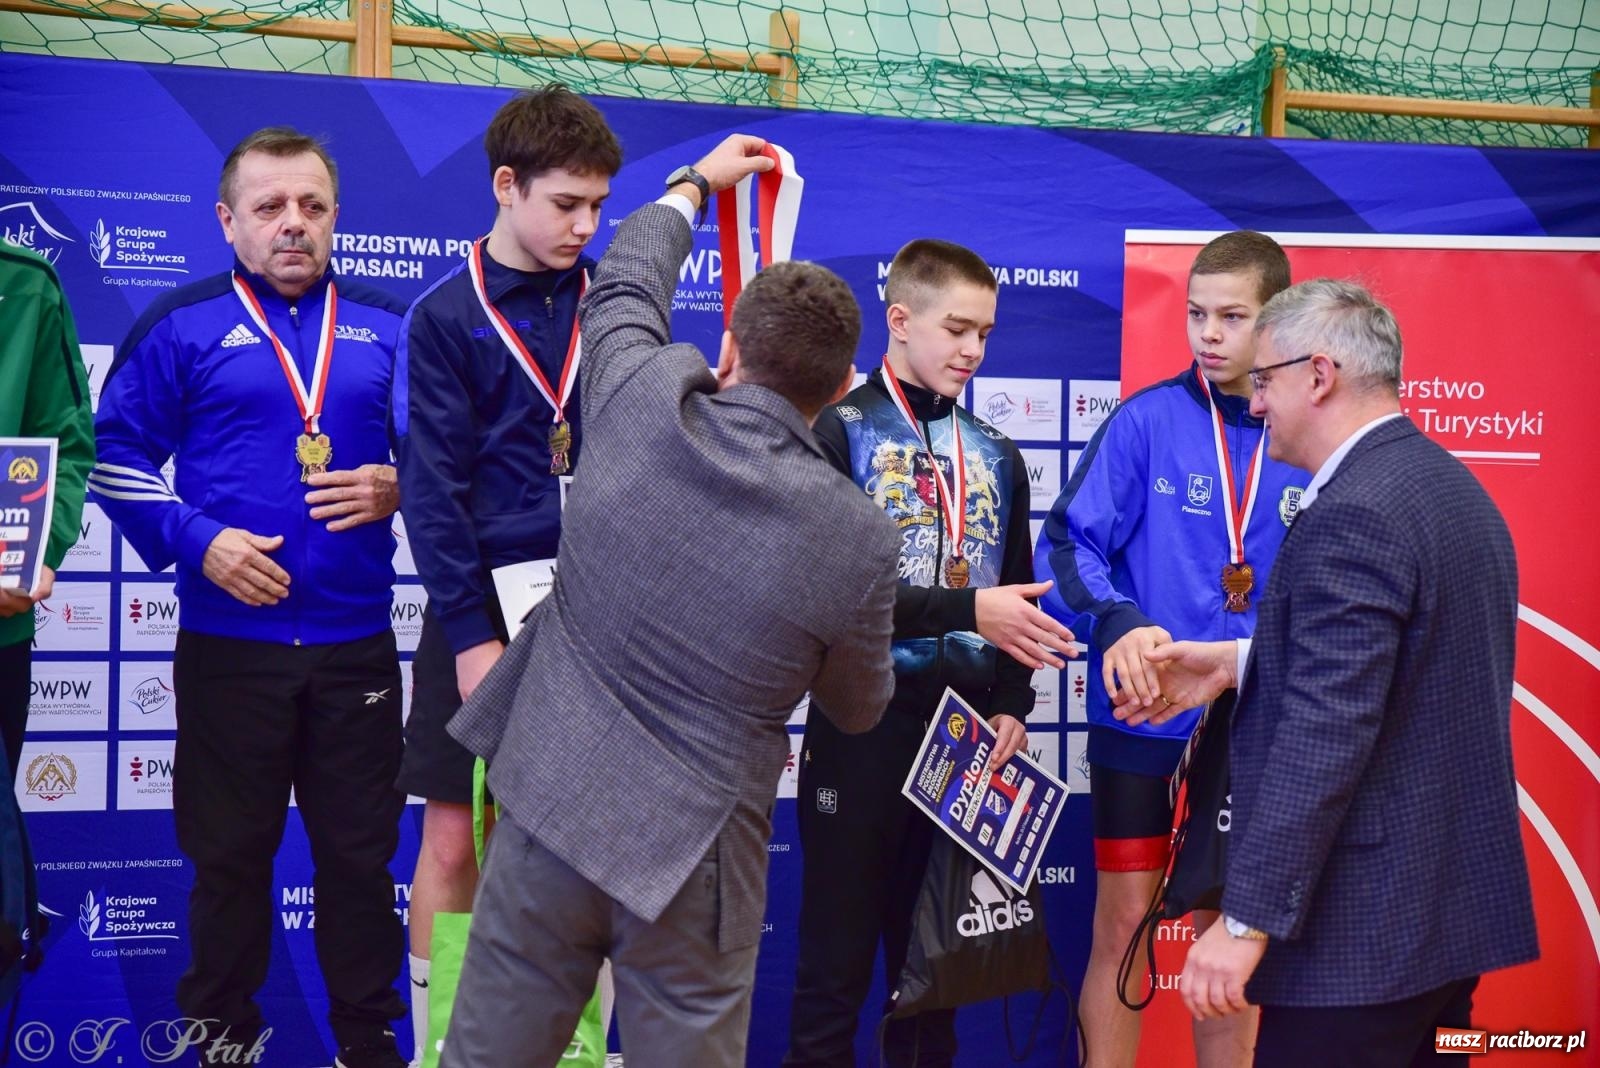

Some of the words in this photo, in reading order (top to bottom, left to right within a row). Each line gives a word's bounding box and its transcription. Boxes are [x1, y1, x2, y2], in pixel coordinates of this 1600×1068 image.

[51, 188, 95, 198] POLSKIEGO
[97, 190, 132, 200] ZWIĄZKU
[134, 191, 191, 203] ZAPAŚNICZEGO
[116, 225, 167, 242] Krajowa
[116, 238, 156, 252] Grupa
[116, 250, 186, 265] Spożywcza
[103, 276, 129, 287] Grupa
[131, 277, 177, 288] Kapitałowa
[1014, 268, 1079, 288] POLSKI
[221, 336, 261, 348] adidas
[1418, 408, 1544, 440] Turystyki
[1182, 505, 1212, 517] Piaseczno
[137, 687, 160, 700] Polski
[142, 694, 167, 708] Cukier
[949, 741, 990, 822] Dyplom
[41, 861, 86, 871] POLSKIEGO
[88, 860, 123, 871] ZWIĄZKU
[125, 858, 183, 869] ZAPAŚNICZEGO
[106, 896, 157, 908] Krajowa
[106, 908, 145, 920] Grupa
[105, 920, 176, 933] Spożywcza
[91, 948, 117, 959] Grupa
[120, 946, 167, 958] Kapitałowa
